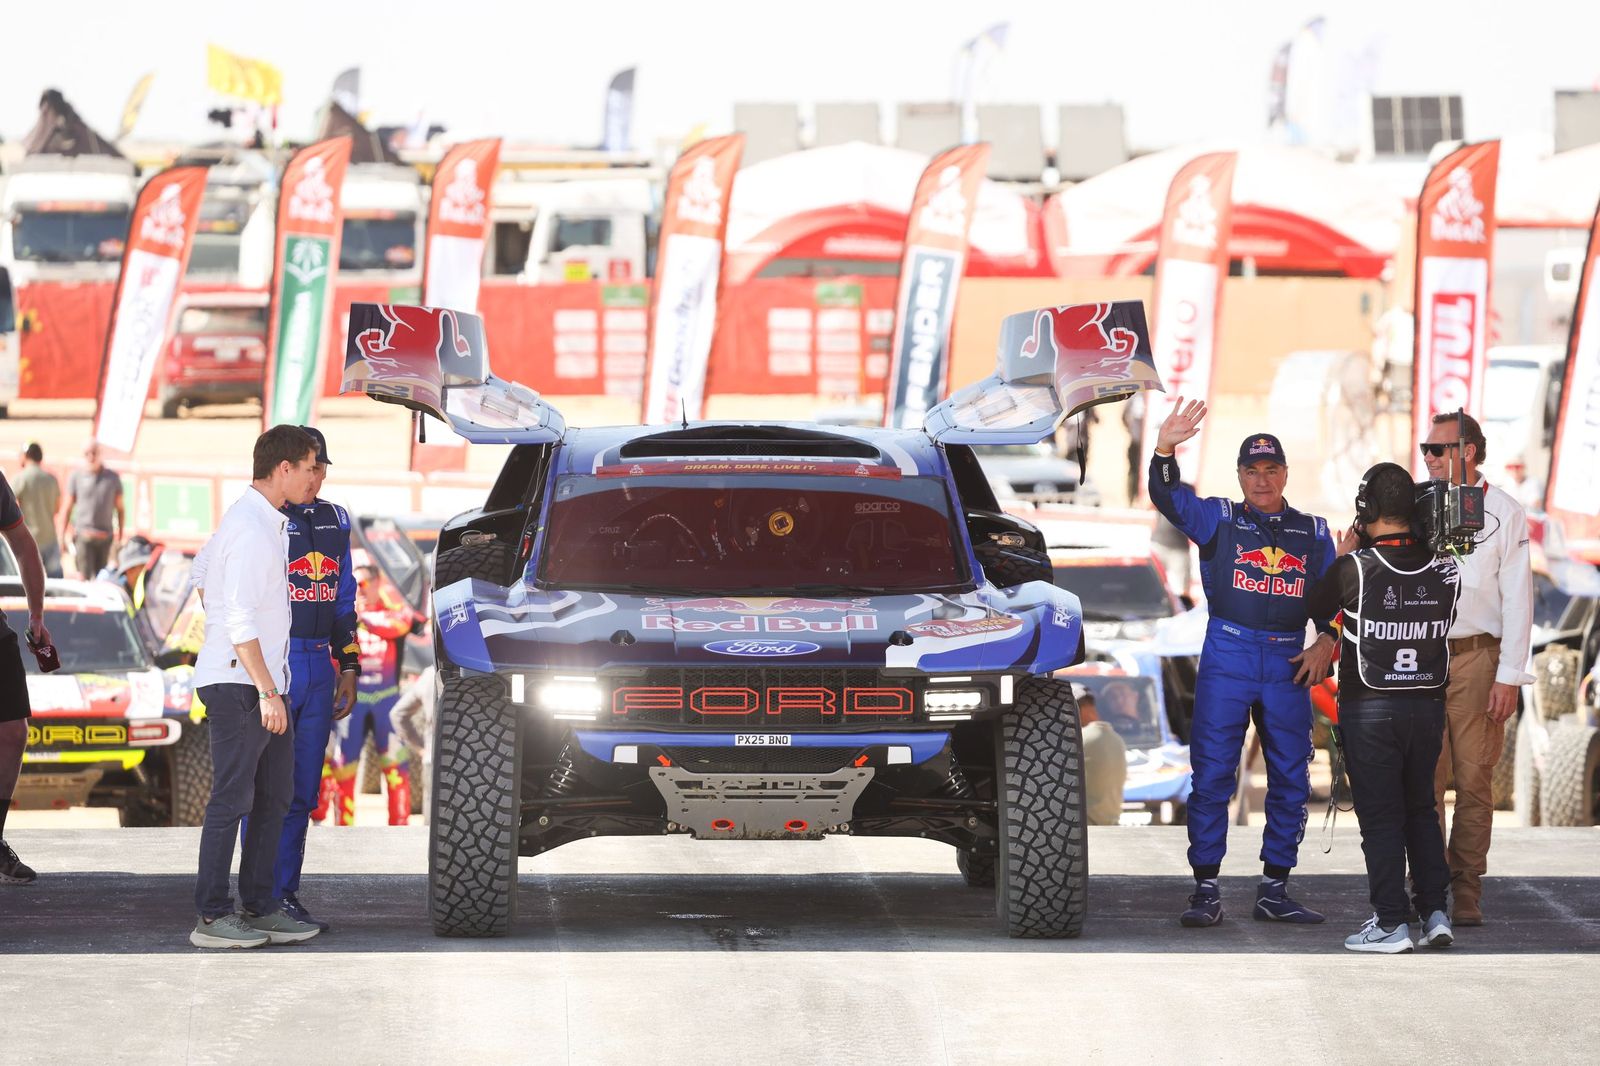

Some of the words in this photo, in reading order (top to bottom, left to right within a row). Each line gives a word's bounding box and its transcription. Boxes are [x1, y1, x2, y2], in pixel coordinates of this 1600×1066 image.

[1432, 297, 1474, 415] OTUL
[1233, 569, 1270, 594] Red
[1272, 577, 1304, 598] Bull
[641, 615, 760, 633] Red
[765, 615, 877, 633] Bull
[1364, 620, 1428, 640] PODIUM
[1431, 619, 1449, 639] TV
[726, 640, 797, 654] Ford
[1393, 648, 1418, 672] 8
[1384, 673, 1434, 681] #Dakar2026
[613, 687, 914, 714] FORD
[737, 735, 765, 745] PX25
